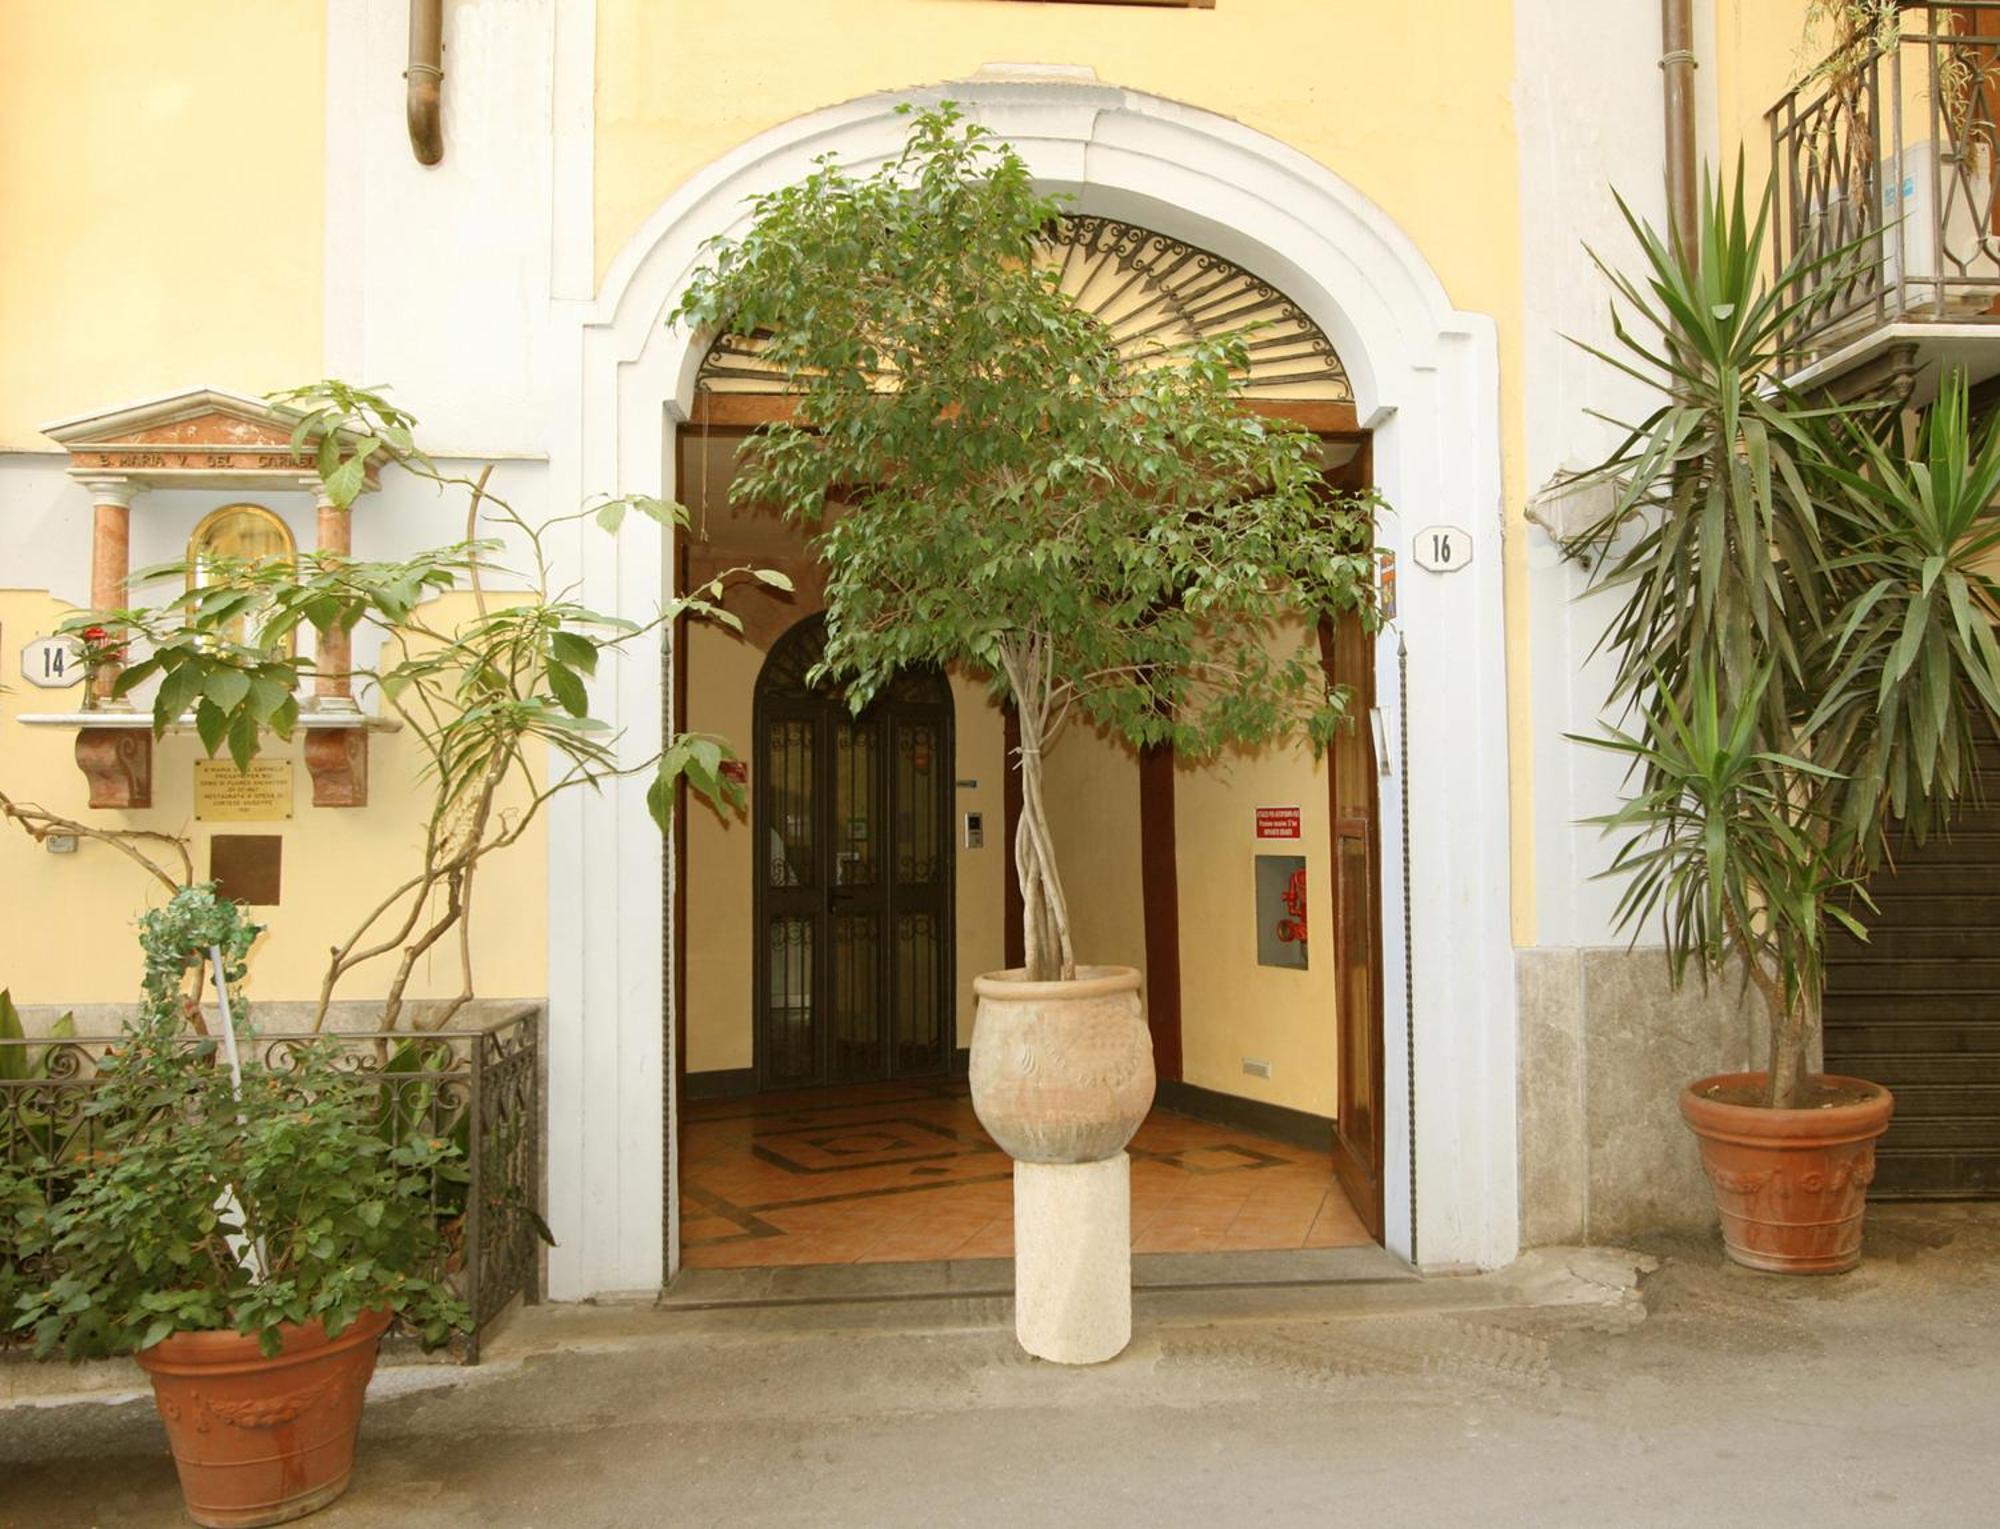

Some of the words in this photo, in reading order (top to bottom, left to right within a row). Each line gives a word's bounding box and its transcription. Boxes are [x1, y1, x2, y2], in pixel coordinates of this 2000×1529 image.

[119, 454, 167, 468] MARIA
[207, 455, 235, 468] DEL
[257, 456, 317, 469] CARMEL
[1433, 534, 1451, 563] 16
[43, 647, 64, 678] 14
